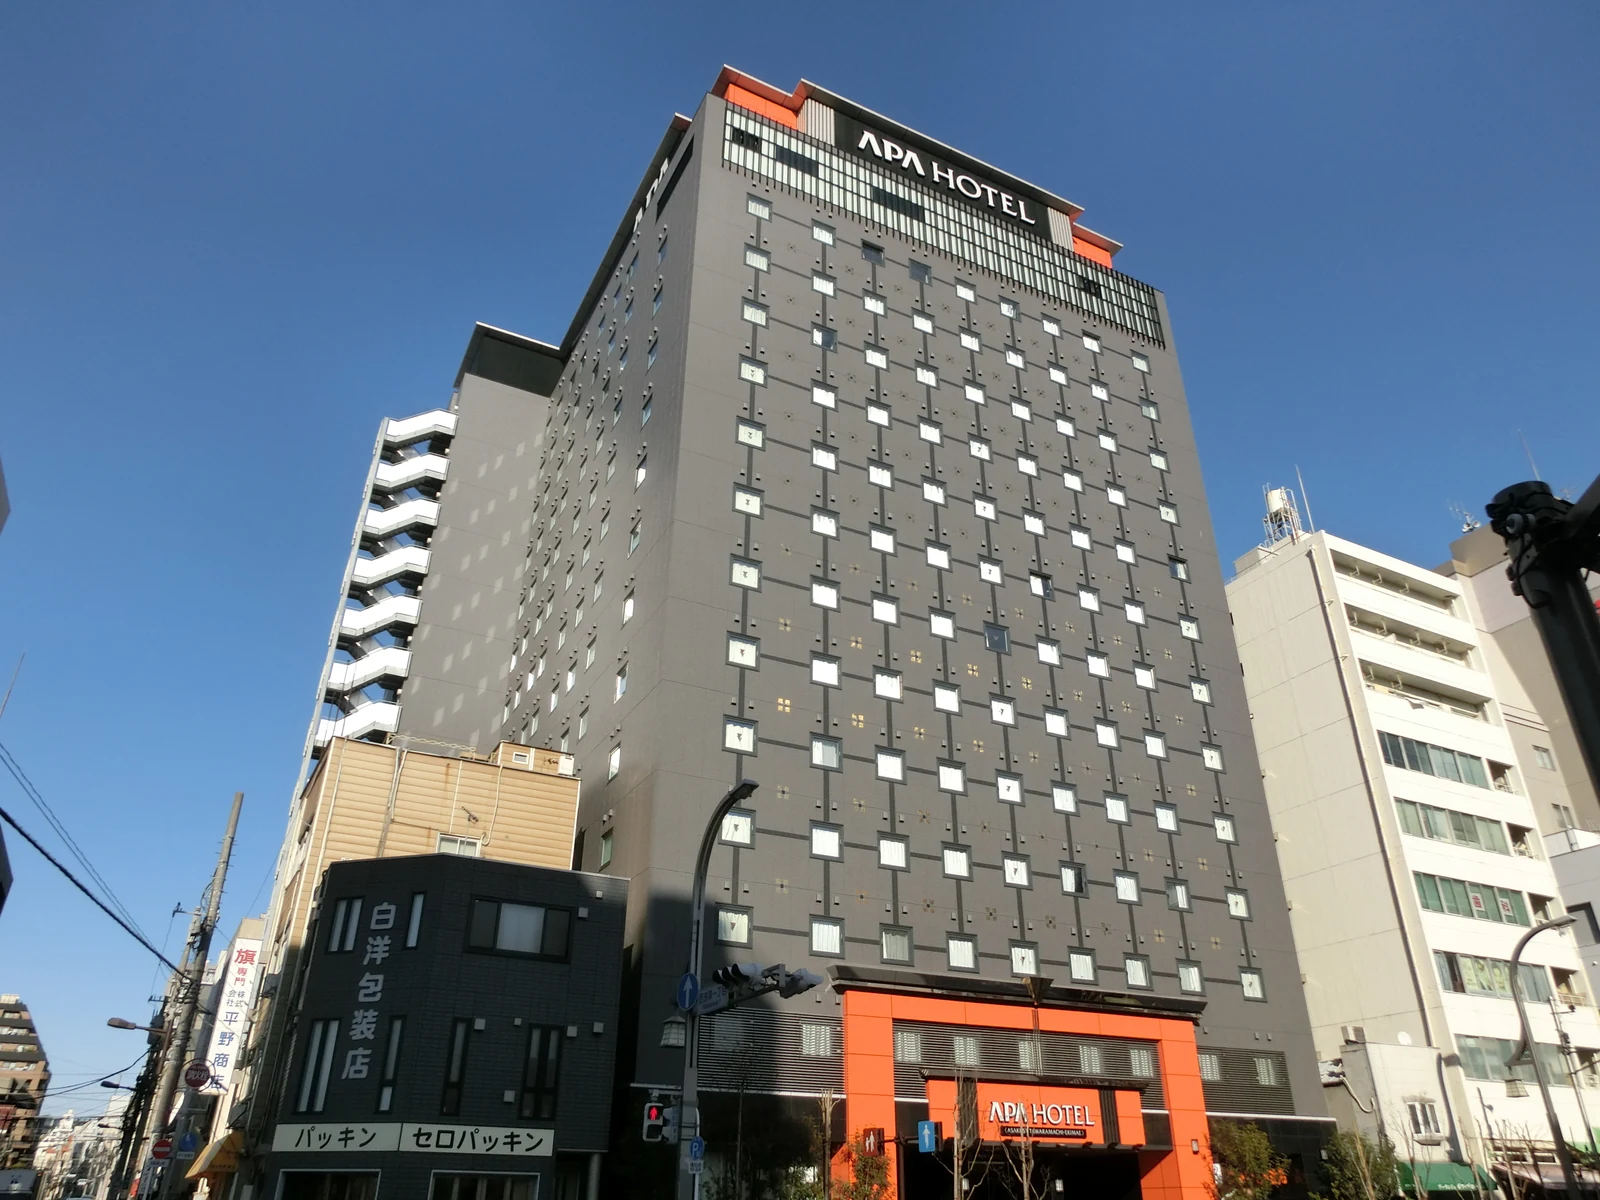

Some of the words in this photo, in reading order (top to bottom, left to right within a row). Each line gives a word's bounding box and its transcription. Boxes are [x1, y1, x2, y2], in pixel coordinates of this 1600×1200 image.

[857, 129, 926, 177] APA
[931, 161, 1036, 225] HOTEL
[341, 902, 397, 1080] 白洋包装店
[989, 1101, 1028, 1123] APA
[1032, 1103, 1095, 1126] HOTEL
[295, 1126, 376, 1148] パッキン
[412, 1128, 543, 1152] セロパッキン
